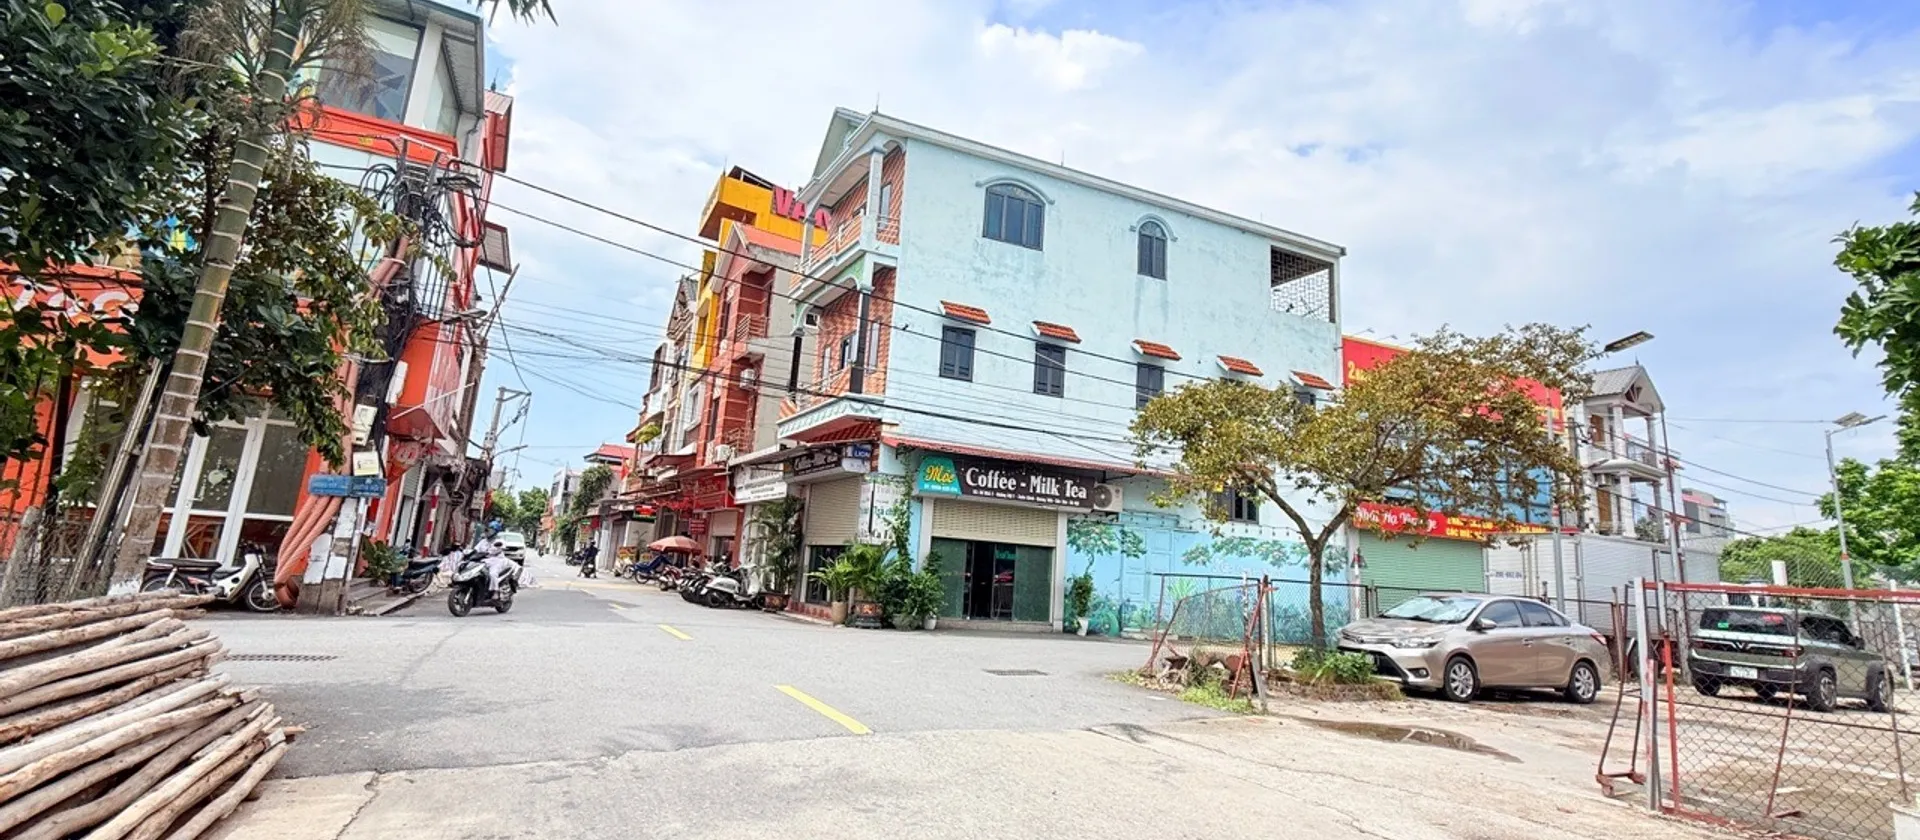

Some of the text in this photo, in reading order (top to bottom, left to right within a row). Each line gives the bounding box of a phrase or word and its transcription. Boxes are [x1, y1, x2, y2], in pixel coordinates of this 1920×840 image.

[966, 467, 1017, 491] Coffee
[1029, 475, 1060, 497] Milk
[1064, 480, 1087, 499] Tea
